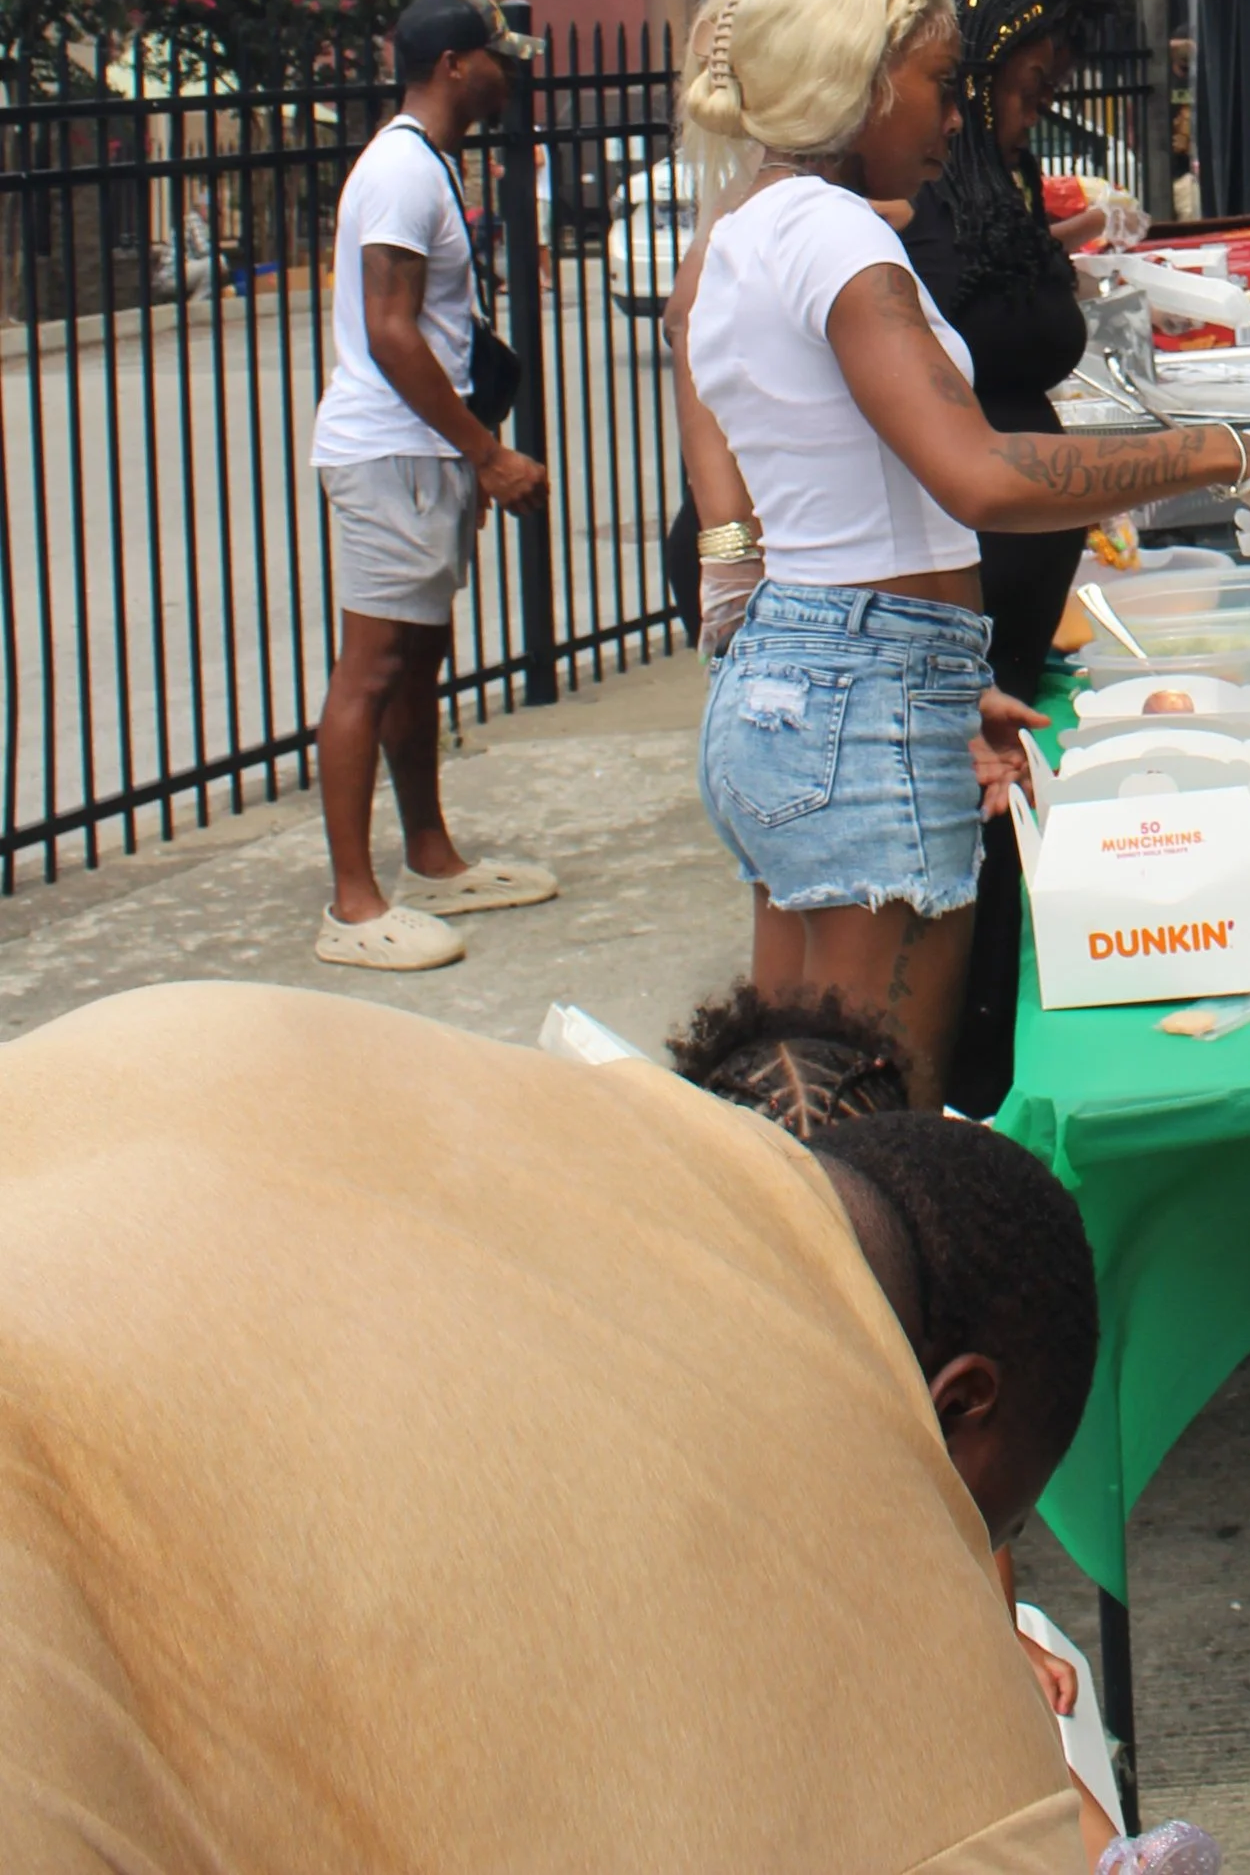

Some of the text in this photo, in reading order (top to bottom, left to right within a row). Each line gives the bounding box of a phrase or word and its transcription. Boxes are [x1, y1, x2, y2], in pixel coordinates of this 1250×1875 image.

[1140, 821, 1161, 834] 50
[1101, 830, 1203, 853] MUNCHKINS
[1088, 920, 1235, 960] DUNKIN'
